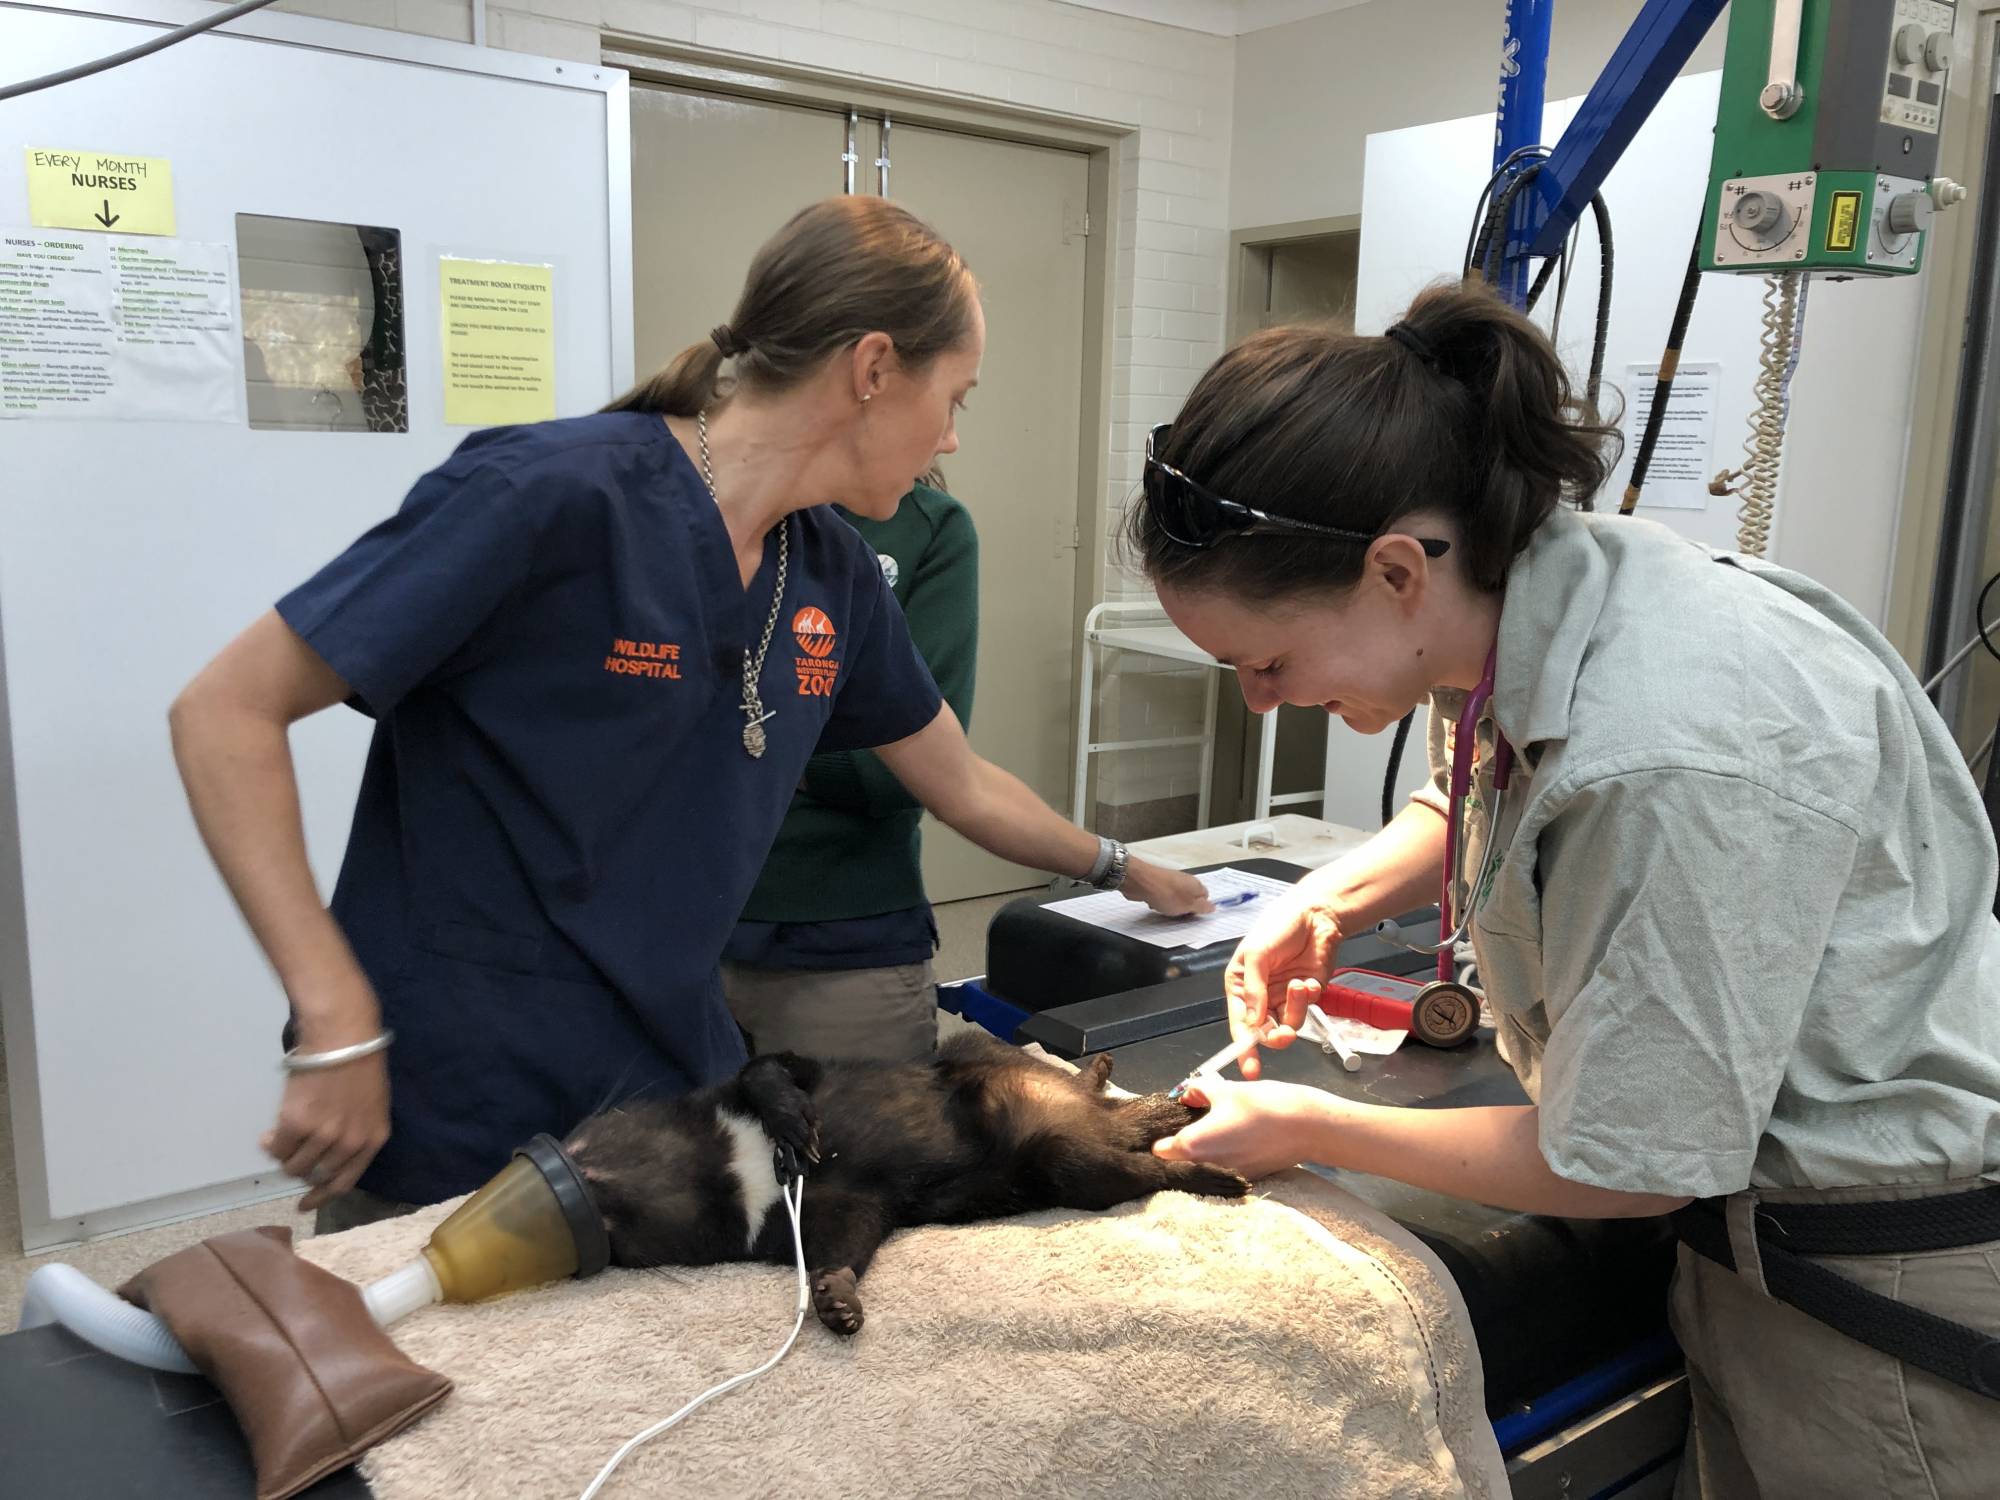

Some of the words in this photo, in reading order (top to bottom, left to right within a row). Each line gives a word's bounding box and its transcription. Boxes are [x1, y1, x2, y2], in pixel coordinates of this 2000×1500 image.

[34, 152, 80, 172] EVERY
[96, 158, 147, 178] MONTH
[71, 173, 137, 191] NURSES
[5, 239, 36, 247] NURSES
[44, 241, 84, 251] ORDERING
[449, 277, 489, 287] TREATMENT
[490, 281, 512, 289] ROOM
[513, 283, 546, 292] ETIQUETTE
[614, 639, 681, 660] WILDLIFE
[604, 656, 682, 679] HOSPITAL
[795, 658, 840, 671] TARONGA
